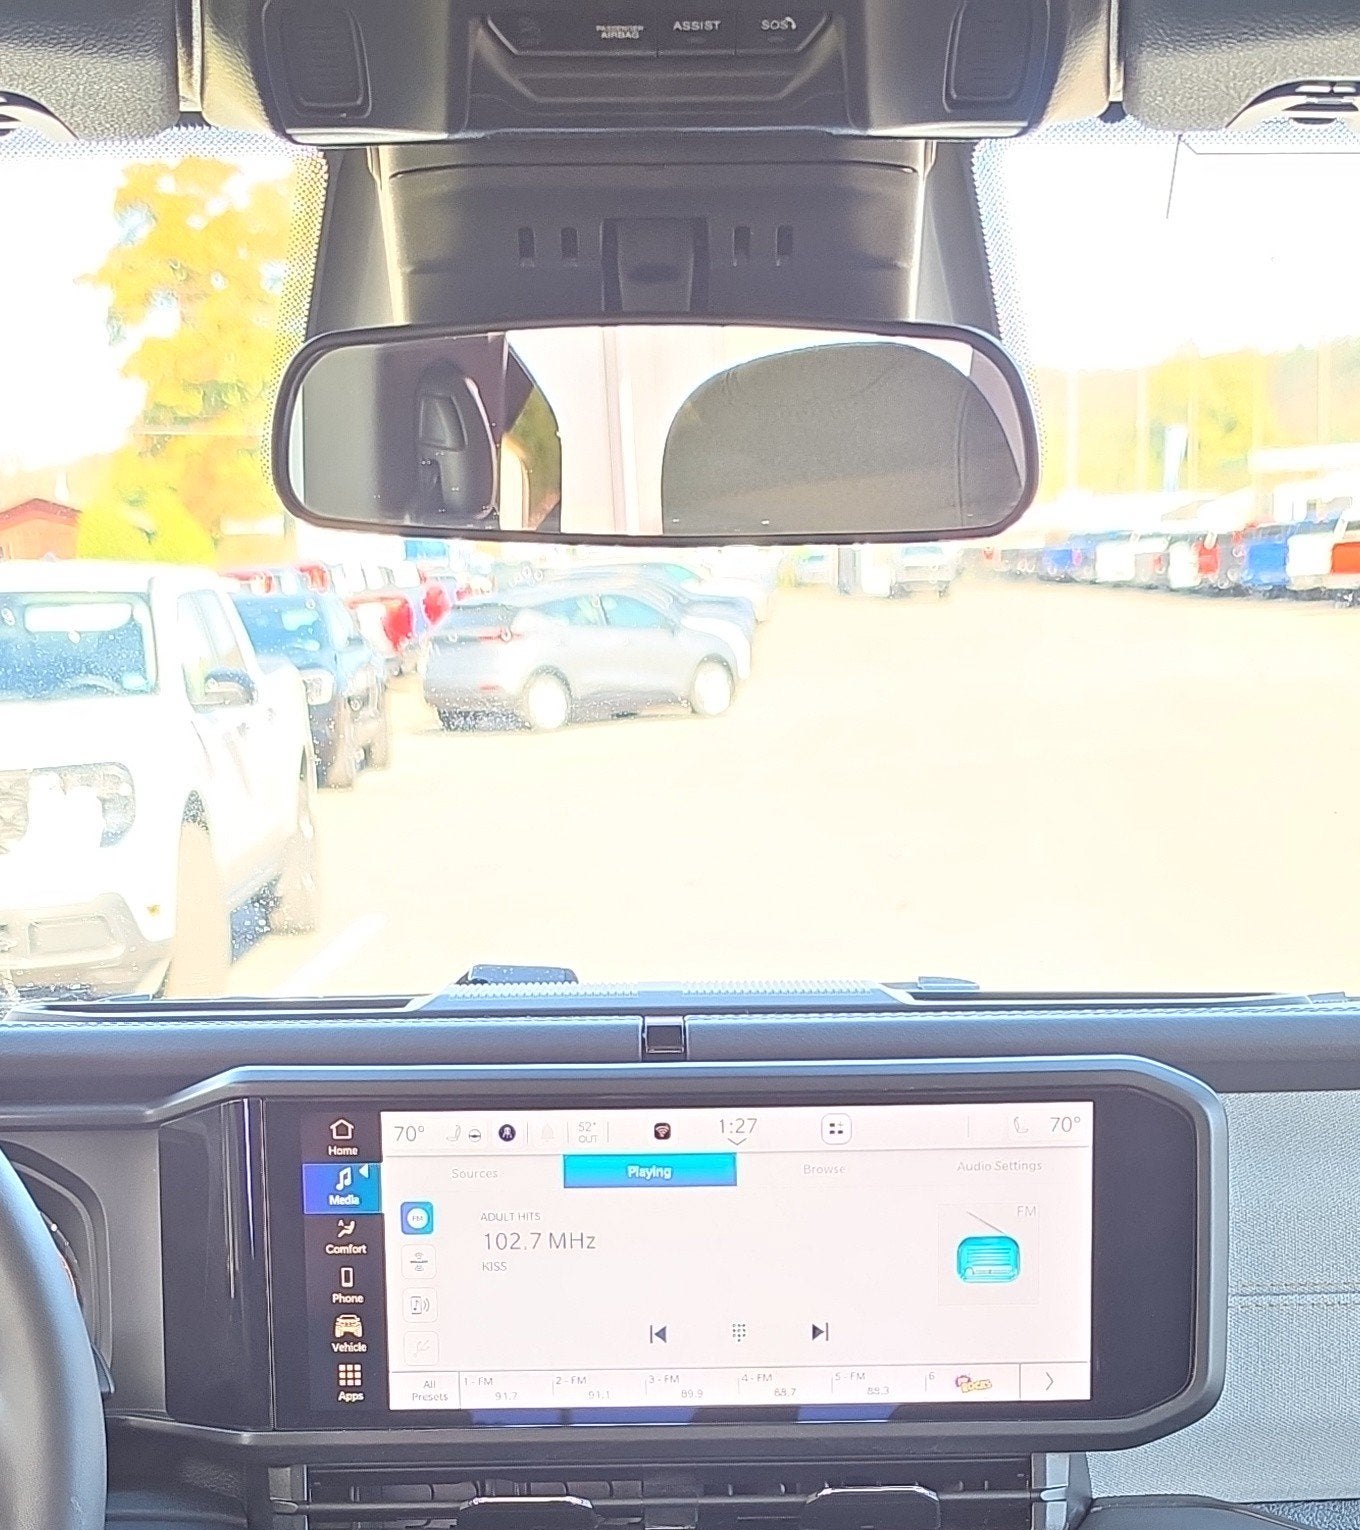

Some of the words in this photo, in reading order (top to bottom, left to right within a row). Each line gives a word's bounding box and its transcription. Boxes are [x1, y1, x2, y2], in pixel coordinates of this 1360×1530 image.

[673, 20, 721, 32] ASSIST
[761, 19, 788, 31] SOS
[601, 31, 639, 40] AIRBAG
[719, 1117, 758, 1134] 1:27
[1049, 1116, 1081, 1133] 70°
[393, 1125, 425, 1142] 70°
[578, 1135, 597, 1143] OUT
[328, 1146, 359, 1157] Home
[803, 1163, 846, 1175] Browse
[957, 1160, 992, 1172] Audio
[994, 1159, 1042, 1173] Settings
[451, 1168, 499, 1179] Sources
[627, 1165, 672, 1180] Playing
[328, 1195, 360, 1206] Media
[480, 1212, 515, 1222] ADULT
[519, 1211, 541, 1221] HITS
[1016, 1206, 1037, 1218] FM
[484, 1232, 542, 1251] 102.7
[548, 1231, 596, 1250] MHz
[325, 1243, 367, 1255] Comfort
[482, 1261, 507, 1272] KISS
[332, 1293, 364, 1304] Phone
[331, 1342, 367, 1352] Vehicle
[477, 1377, 494, 1386] FM
[571, 1376, 587, 1385] FM
[664, 1375, 680, 1384] FM
[757, 1373, 773, 1382] FM
[850, 1372, 866, 1381] FM
[423, 1379, 436, 1389] All
[338, 1391, 364, 1402] Apps
[412, 1391, 449, 1402] Presets
[495, 1391, 518, 1400] 91.7
[588, 1390, 611, 1399] 91.1
